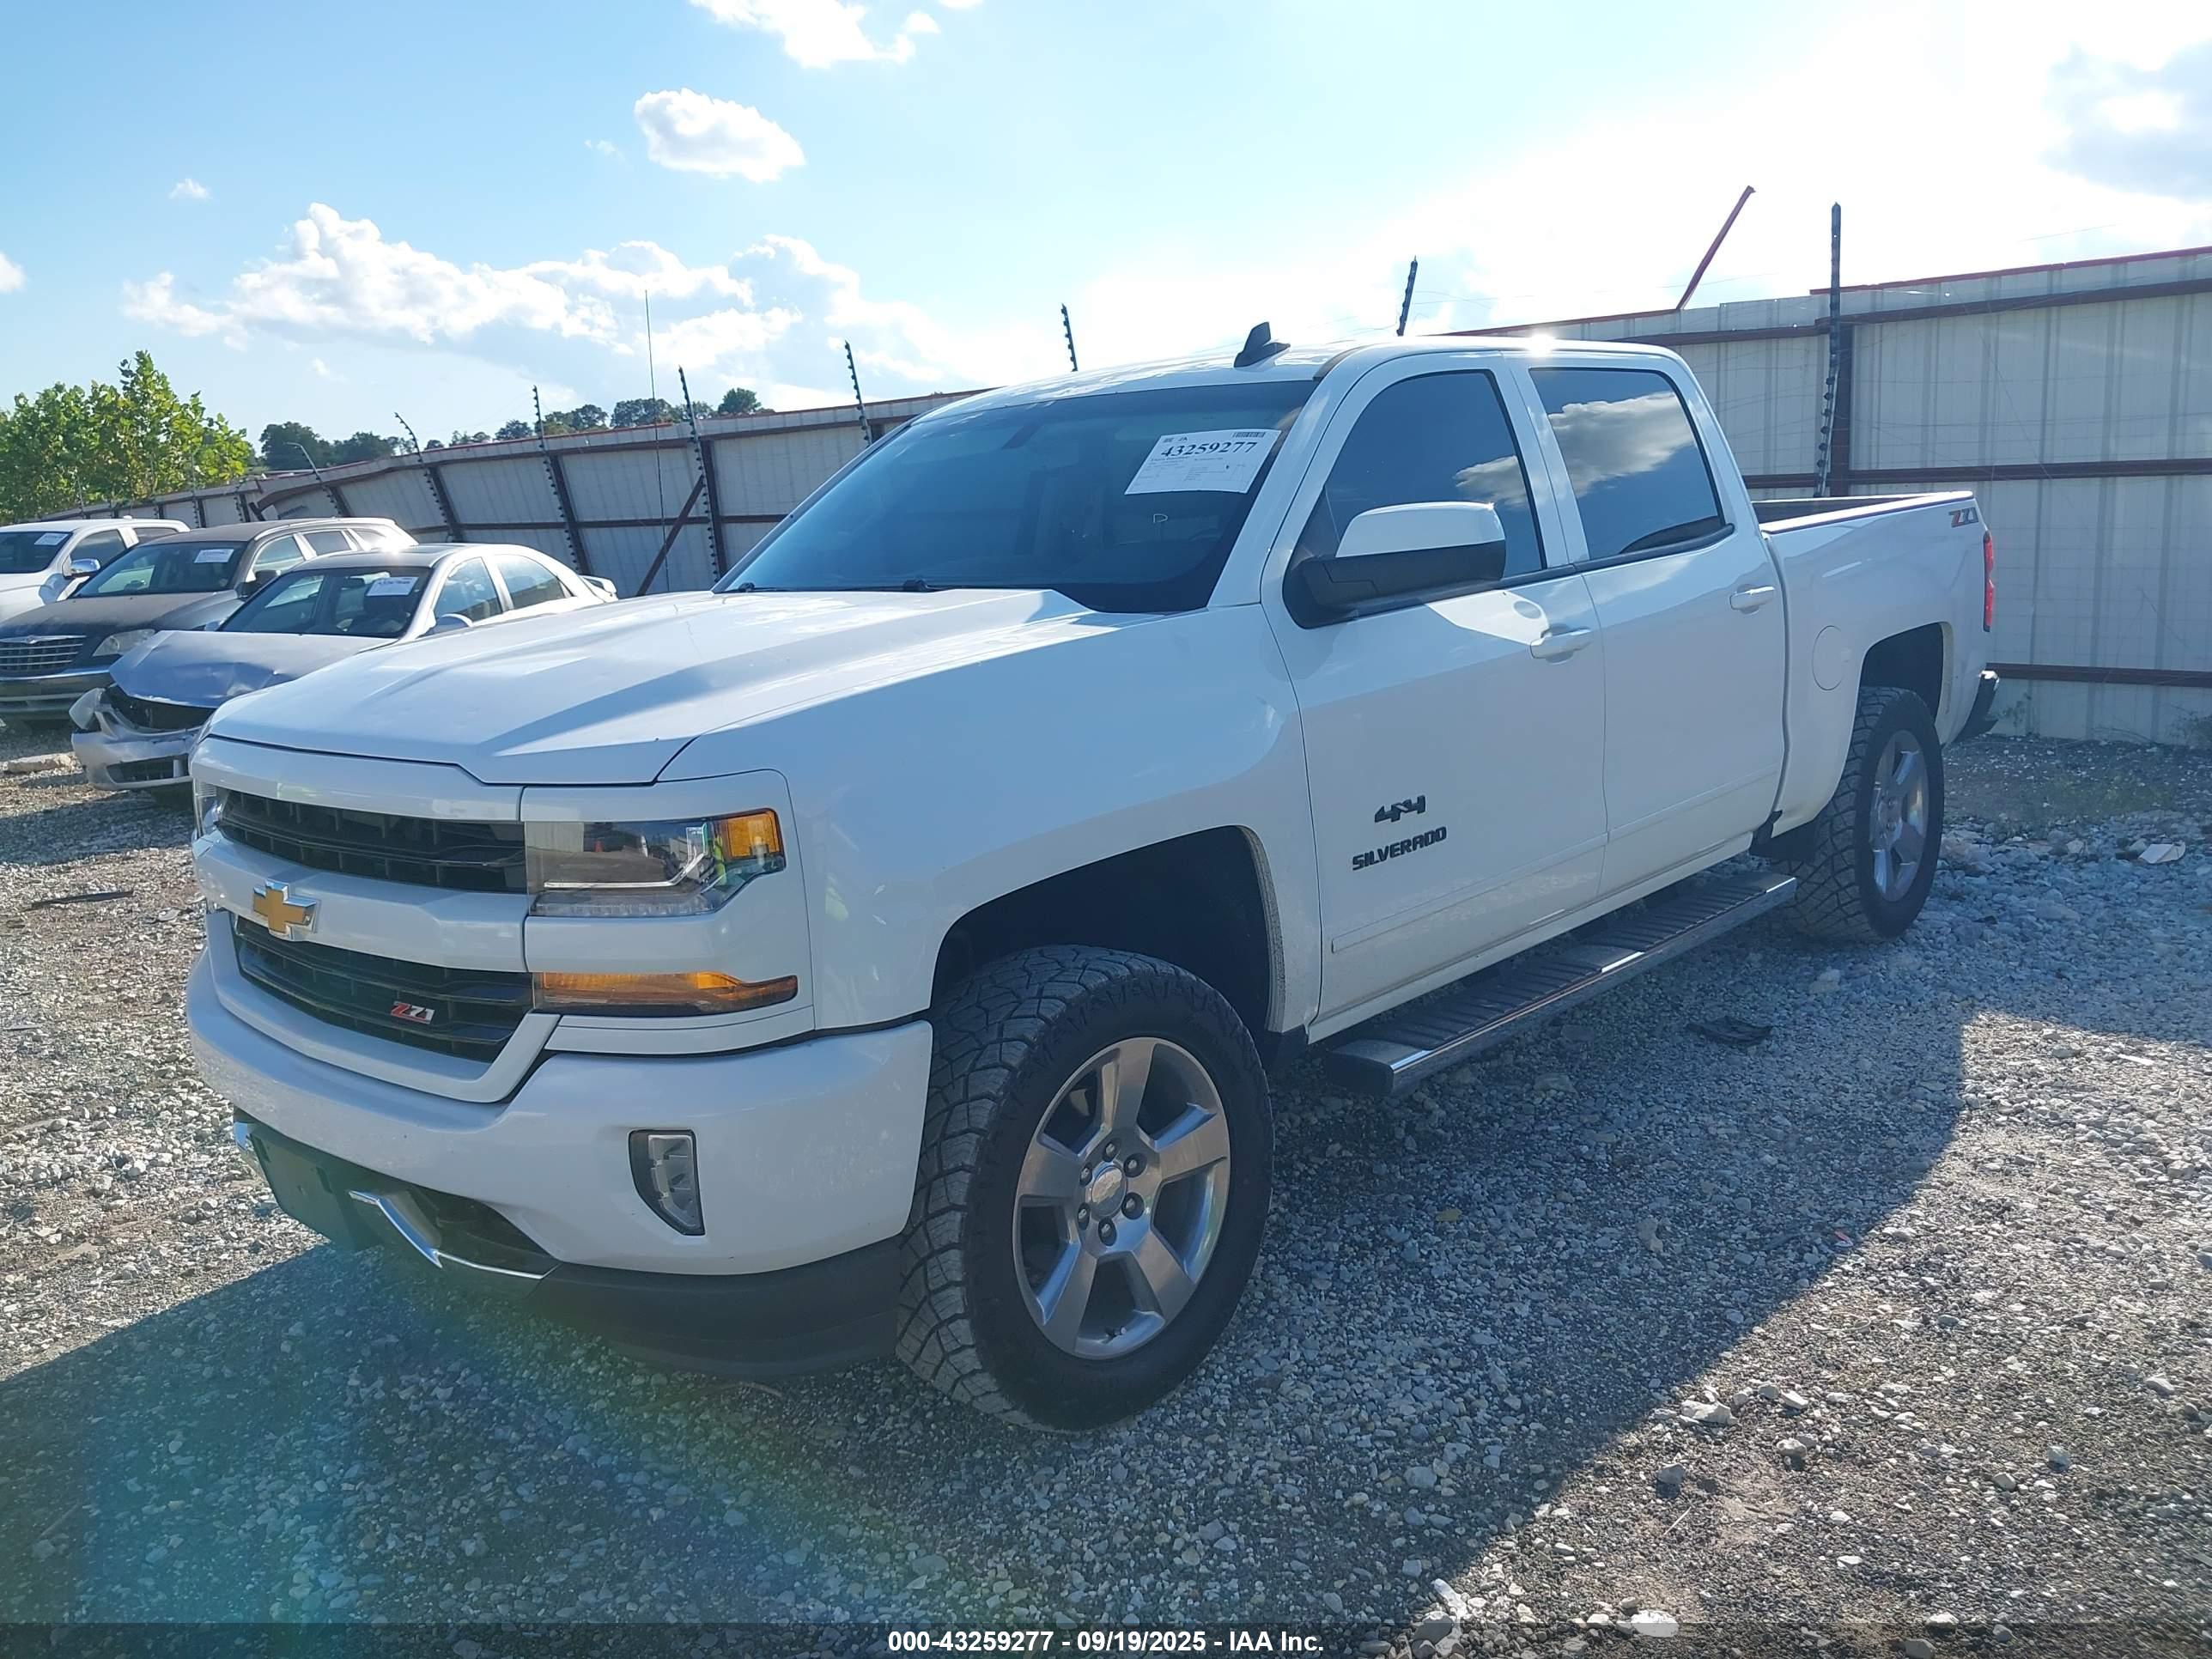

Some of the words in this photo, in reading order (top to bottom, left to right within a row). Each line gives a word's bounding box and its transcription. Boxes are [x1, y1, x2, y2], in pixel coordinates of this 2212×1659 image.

[1161, 441, 1258, 457] 43259277
[1948, 507, 1979, 528] Z71
[1352, 826, 1447, 871] SILVERADO
[391, 1000, 435, 1024] Z71
